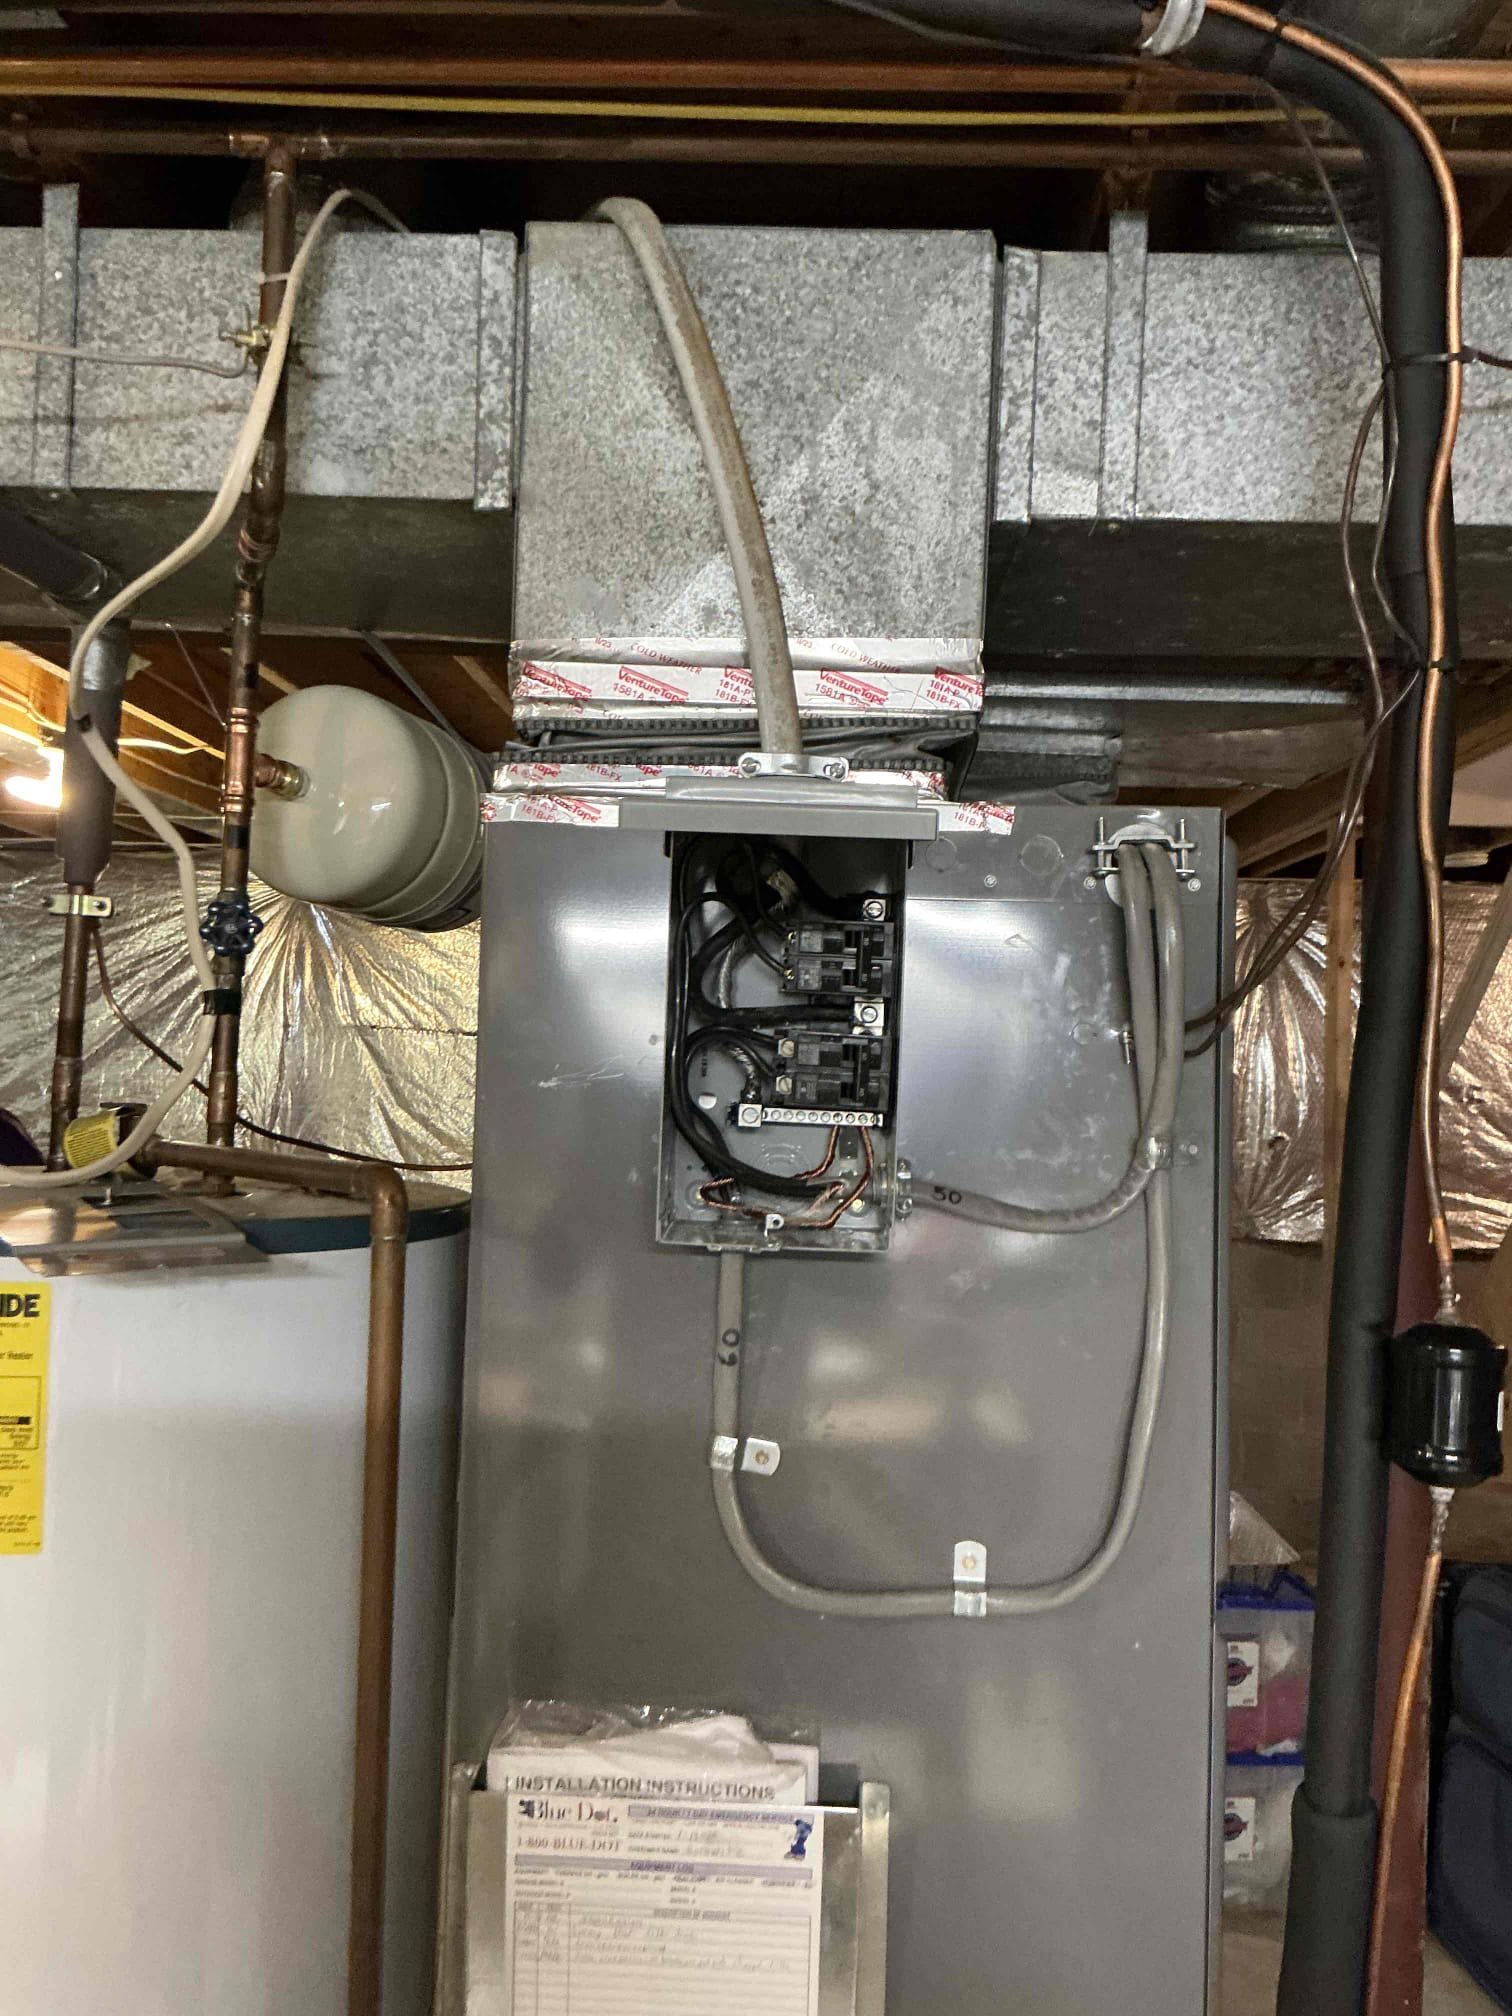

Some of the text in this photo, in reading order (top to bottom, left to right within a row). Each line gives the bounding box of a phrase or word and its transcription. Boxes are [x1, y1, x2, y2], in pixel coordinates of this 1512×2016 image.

[630, 642, 657, 659] COLD
[613, 682, 645, 702] 1581A
[619, 667, 689, 704] VentureTape
[821, 670, 888, 705] VentureTape
[926, 689, 961, 709] 181B-FX
[934, 1185, 962, 1204] 50
[515, 1775, 775, 1800] INSTALLATION INSTRUCTIONS
